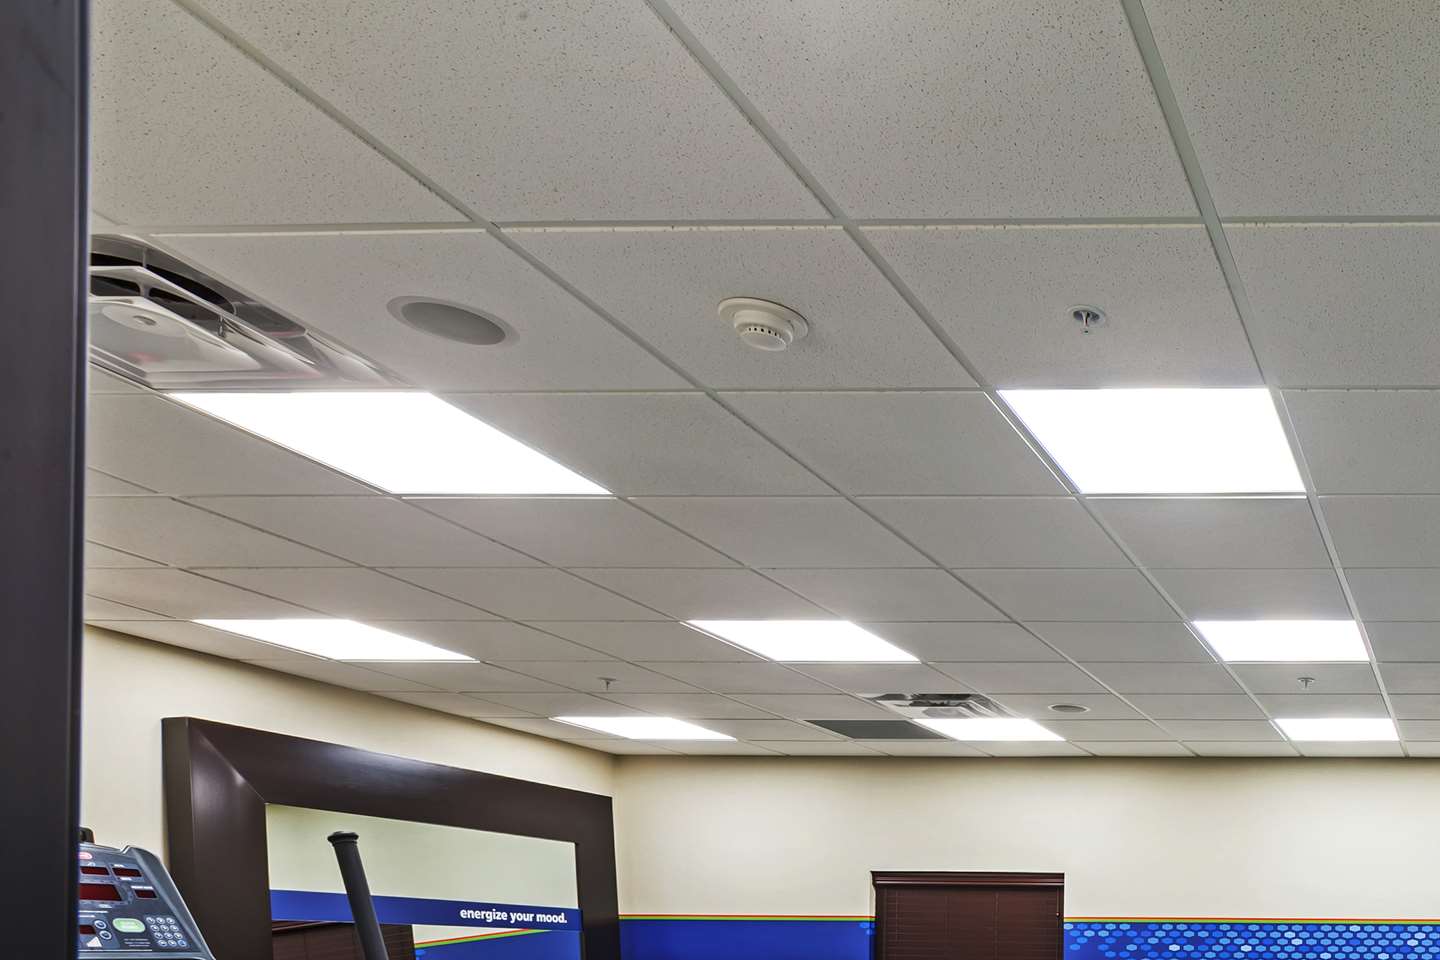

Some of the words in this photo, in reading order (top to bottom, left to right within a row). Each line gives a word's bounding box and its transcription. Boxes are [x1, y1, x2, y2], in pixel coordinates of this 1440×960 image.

[459, 908, 508, 923] energize
[509, 912, 535, 924] your
[536, 912, 568, 924] mood.
